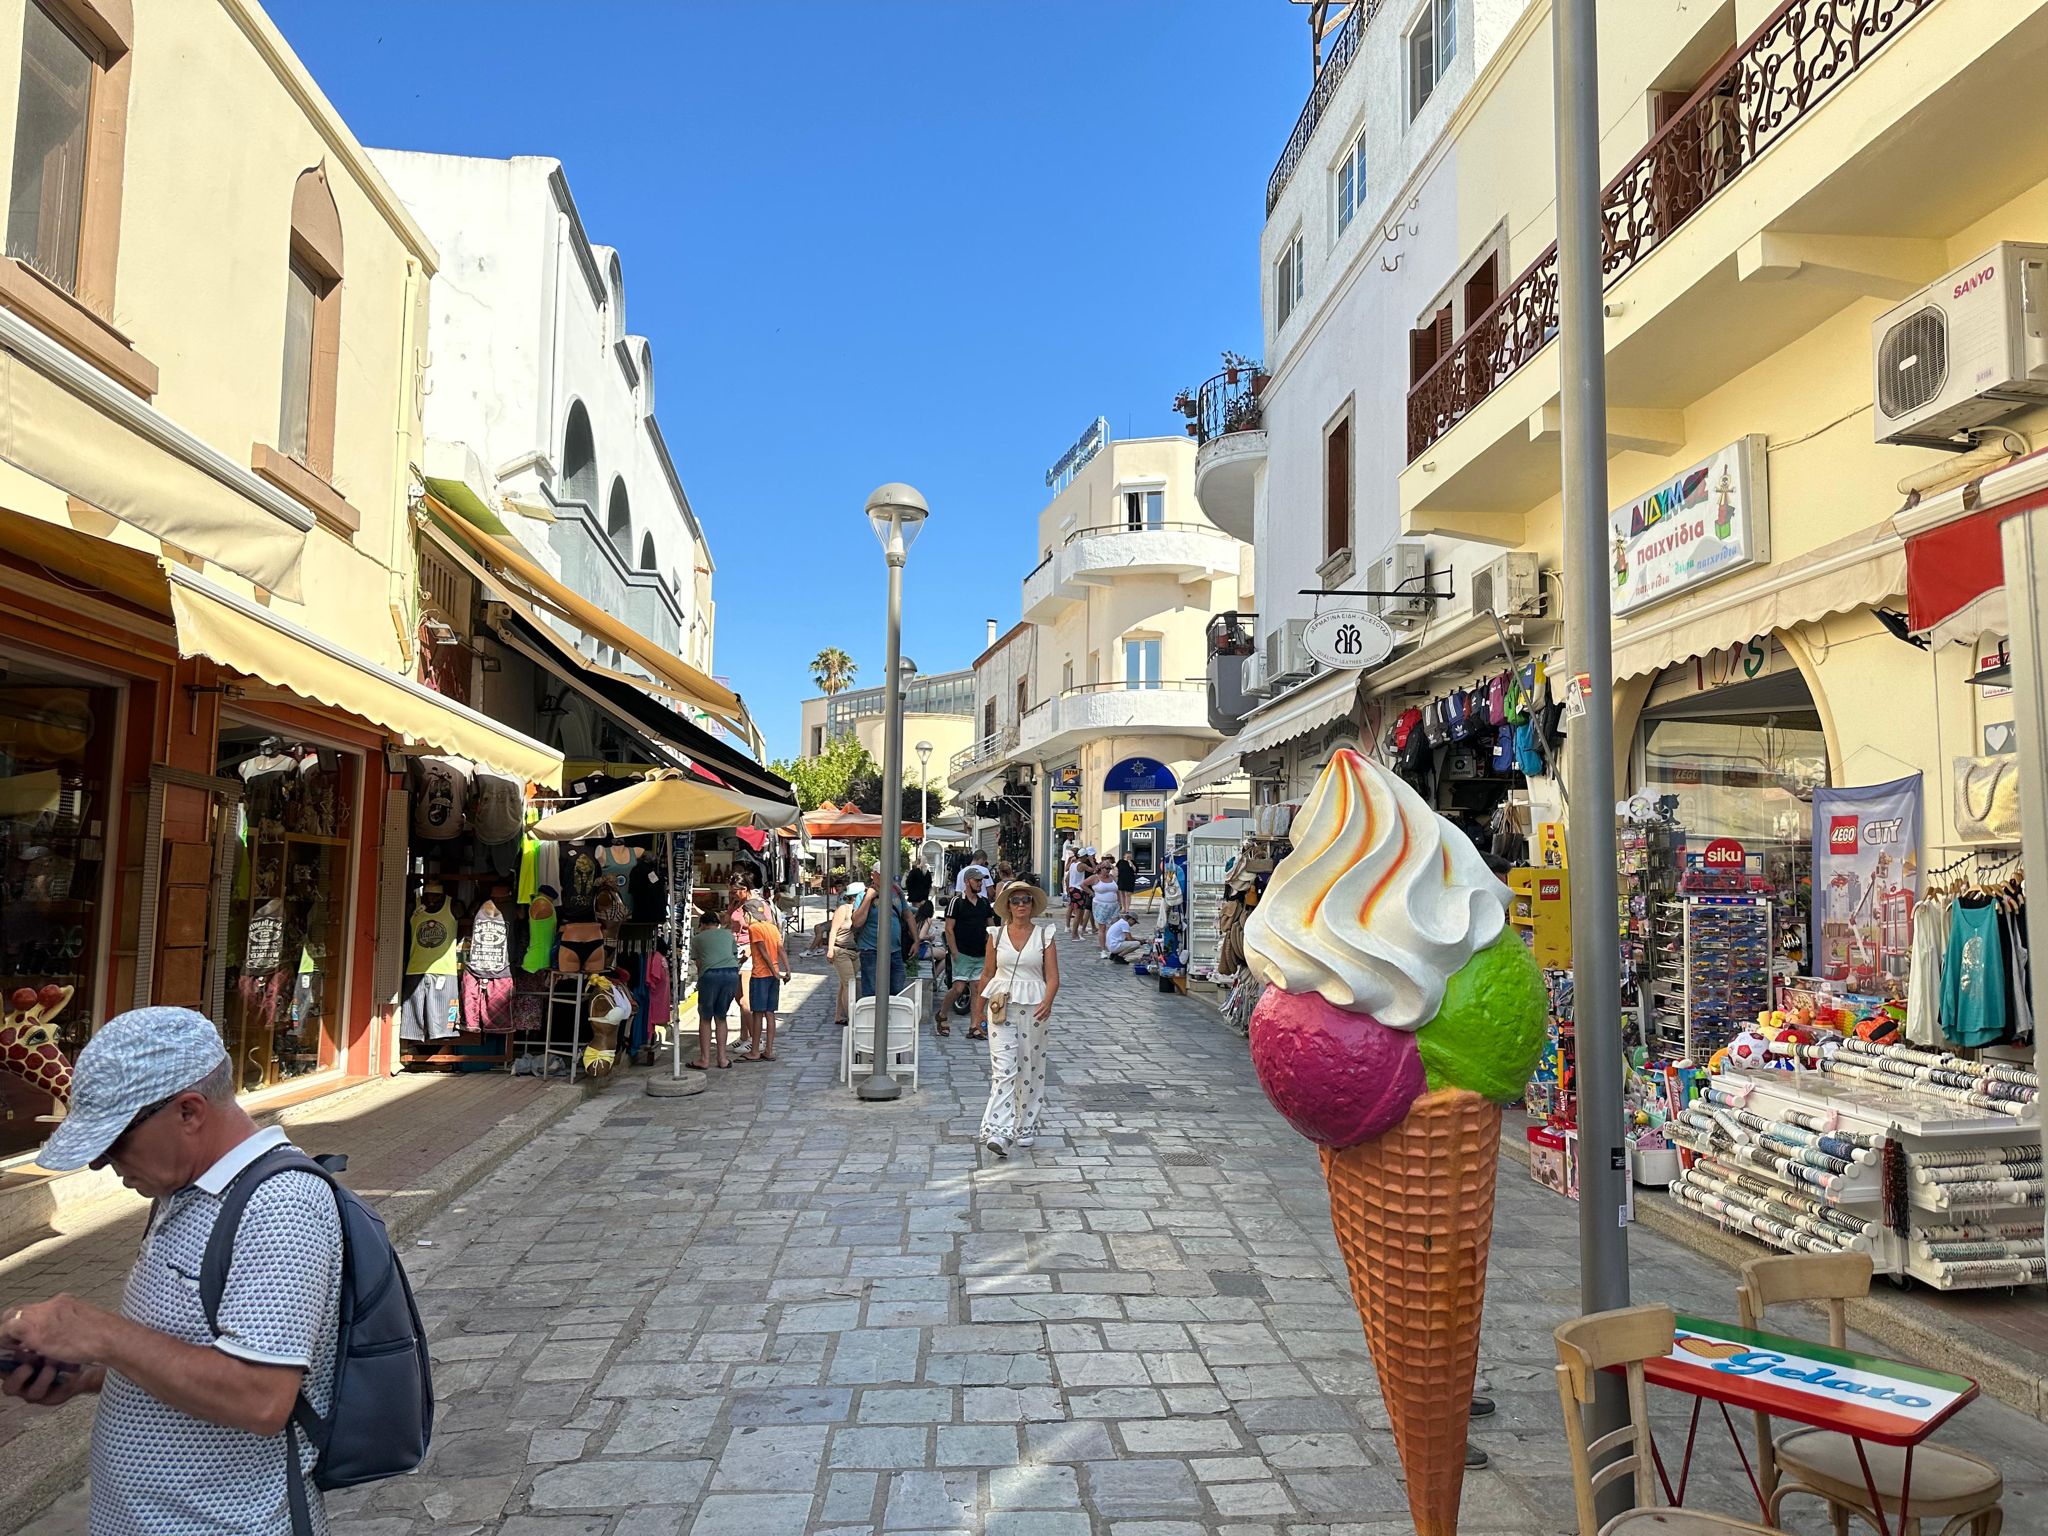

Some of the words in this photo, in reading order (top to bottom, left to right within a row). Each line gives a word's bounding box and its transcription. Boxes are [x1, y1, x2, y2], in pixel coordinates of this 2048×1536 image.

[1953, 266, 1995, 299] SANYO
[1637, 520, 1705, 566] παιχνίδια
[1690, 633, 1765, 690] TOYS
[1130, 798, 1160, 807] EXCHANGE
[1132, 813, 1154, 822] ATM
[1831, 825, 1856, 843] LEGO
[1862, 818, 1903, 845] CITY
[1707, 847, 1742, 862] siku
[1541, 885, 1559, 894] LEGO
[1710, 1352, 1932, 1408] Gelato
